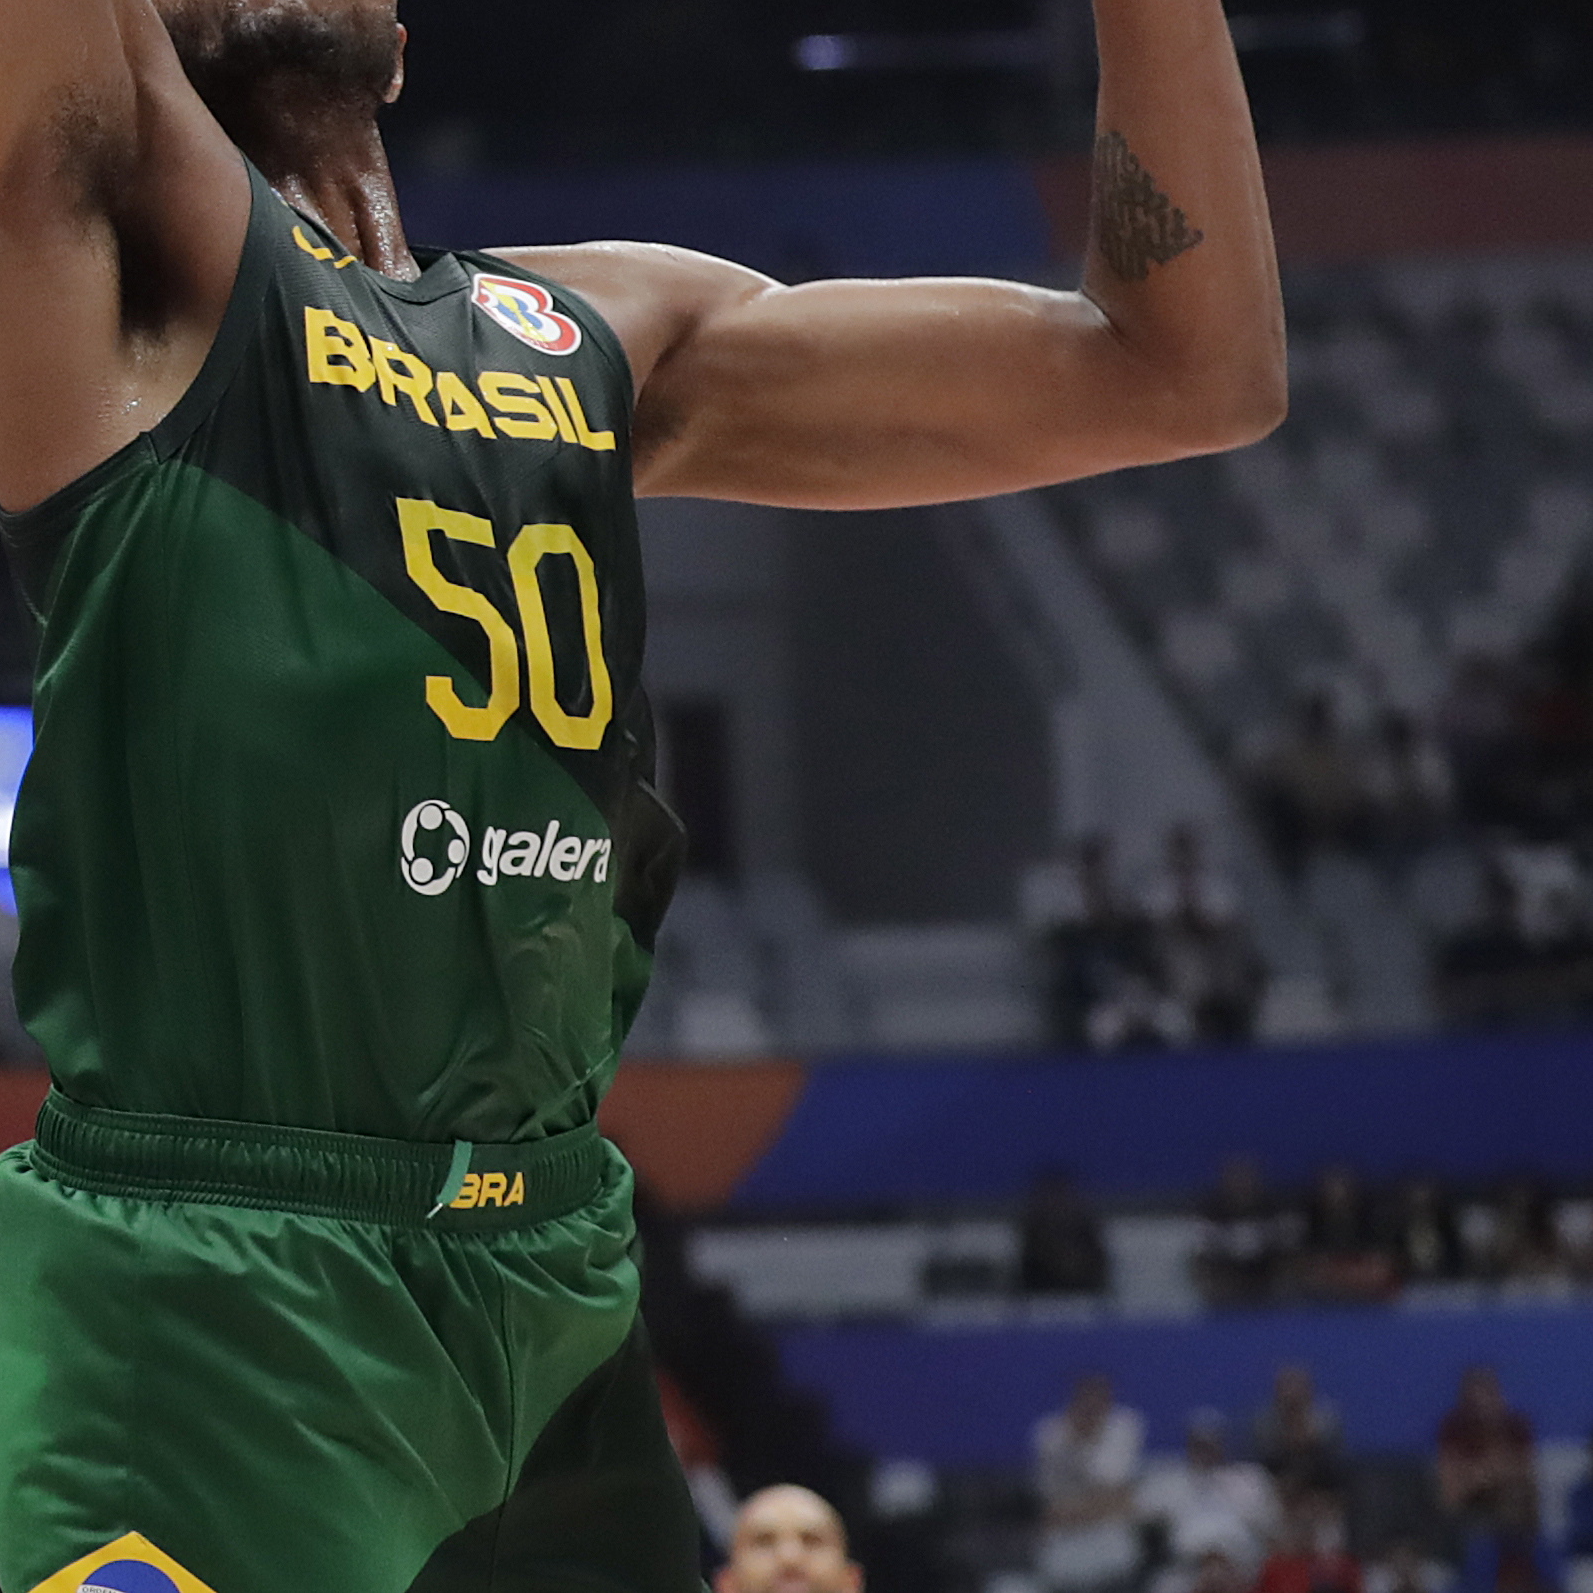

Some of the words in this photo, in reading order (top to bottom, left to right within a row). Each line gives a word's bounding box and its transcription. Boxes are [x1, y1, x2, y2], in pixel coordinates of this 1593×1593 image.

[303, 305, 616, 451] BRASIL
[395, 496, 613, 750] 50
[477, 819, 612, 886] galera
[448, 1172, 525, 1209] BRA
